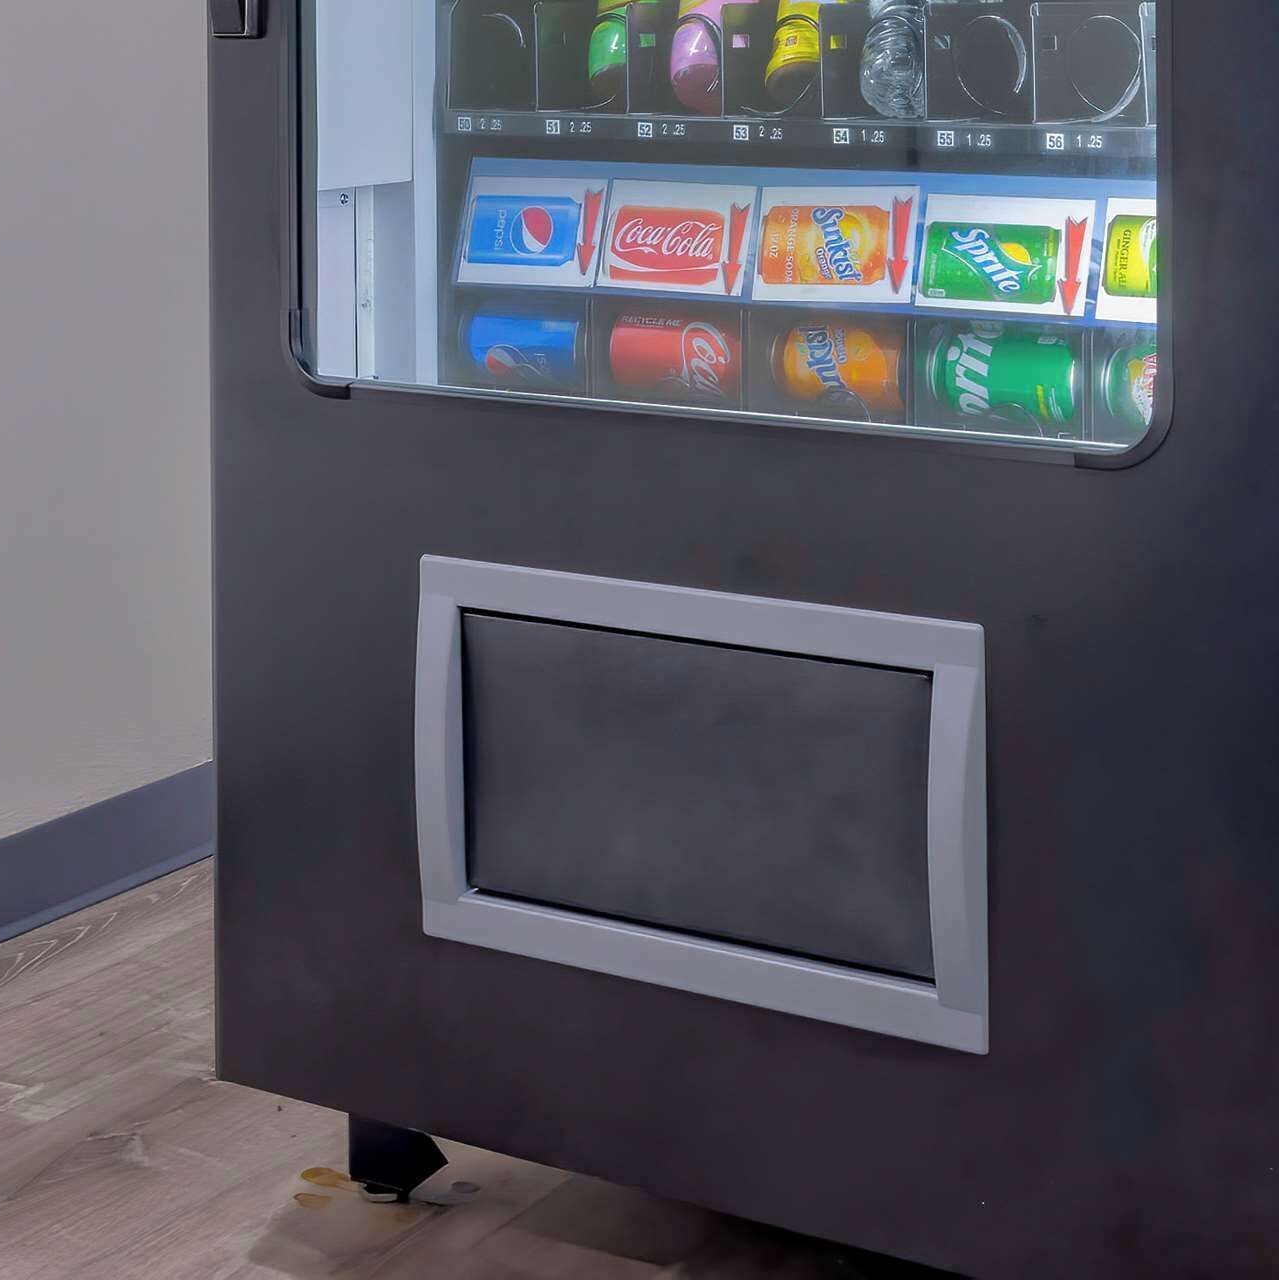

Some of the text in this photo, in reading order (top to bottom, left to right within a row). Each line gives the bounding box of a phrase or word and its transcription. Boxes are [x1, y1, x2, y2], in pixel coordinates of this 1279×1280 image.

[494, 209, 508, 253] pepsi
[811, 206, 864, 282] Sunkist
[1119, 228, 1133, 271] GINGER
[784, 254, 795, 283] SODA
[815, 246, 833, 280] Orange
[949, 227, 1024, 293] Sprite
